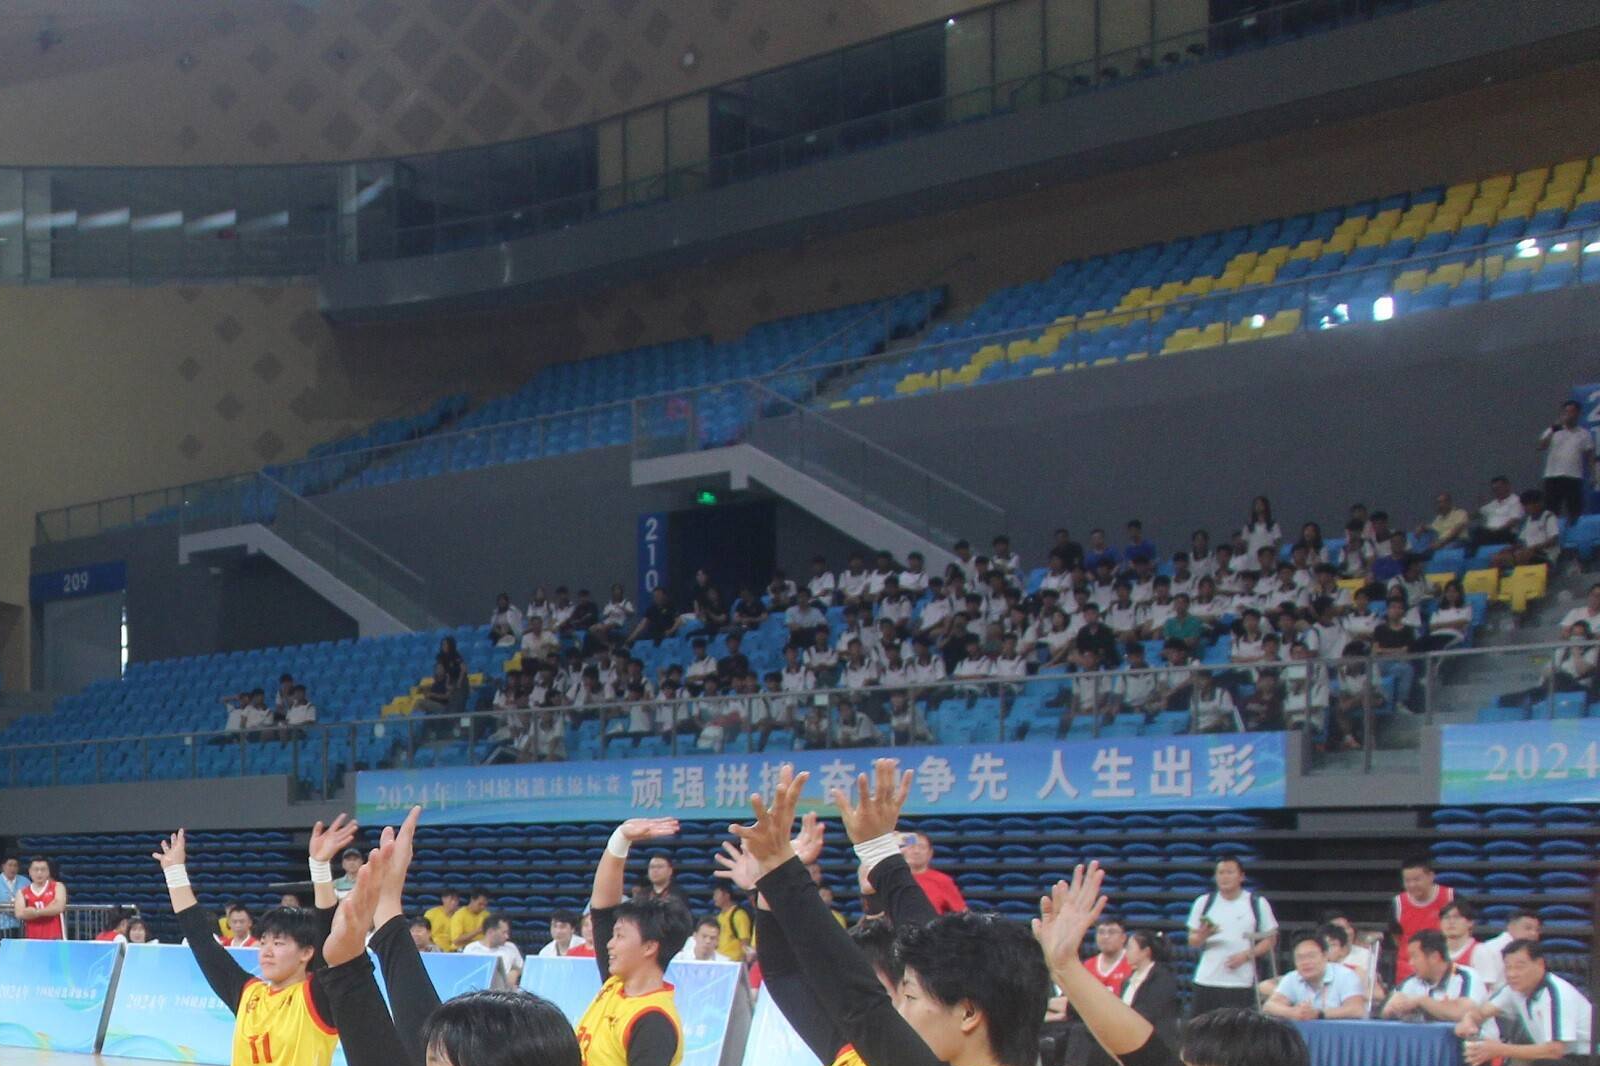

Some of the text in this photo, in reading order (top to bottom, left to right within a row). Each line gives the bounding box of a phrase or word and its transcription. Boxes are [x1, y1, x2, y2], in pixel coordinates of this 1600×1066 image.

[645, 517, 659, 592] 210
[63, 571, 89, 592] 209
[819, 754, 1008, 807] 奋争先
[1036, 743, 1257, 801] 人生出彩
[1486, 740, 1600, 781] 2024
[375, 781, 451, 812] 2024年
